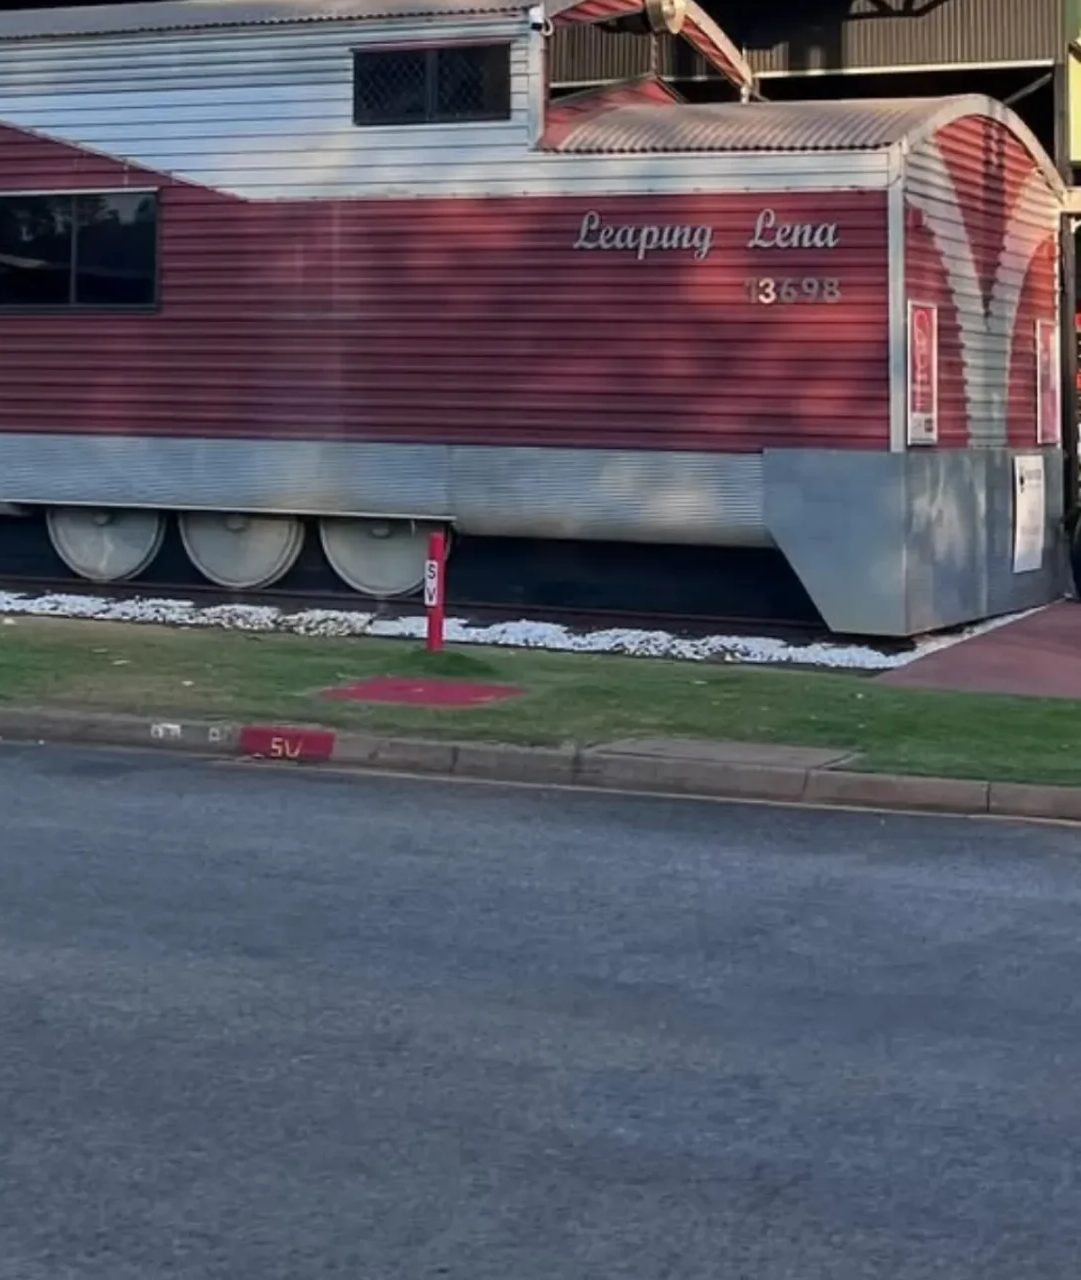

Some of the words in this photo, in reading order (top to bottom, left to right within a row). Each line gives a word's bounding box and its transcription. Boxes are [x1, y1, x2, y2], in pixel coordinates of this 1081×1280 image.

[573, 210, 713, 260] Leaping
[747, 208, 839, 248] Lena
[744, 277, 841, 304] 13698
